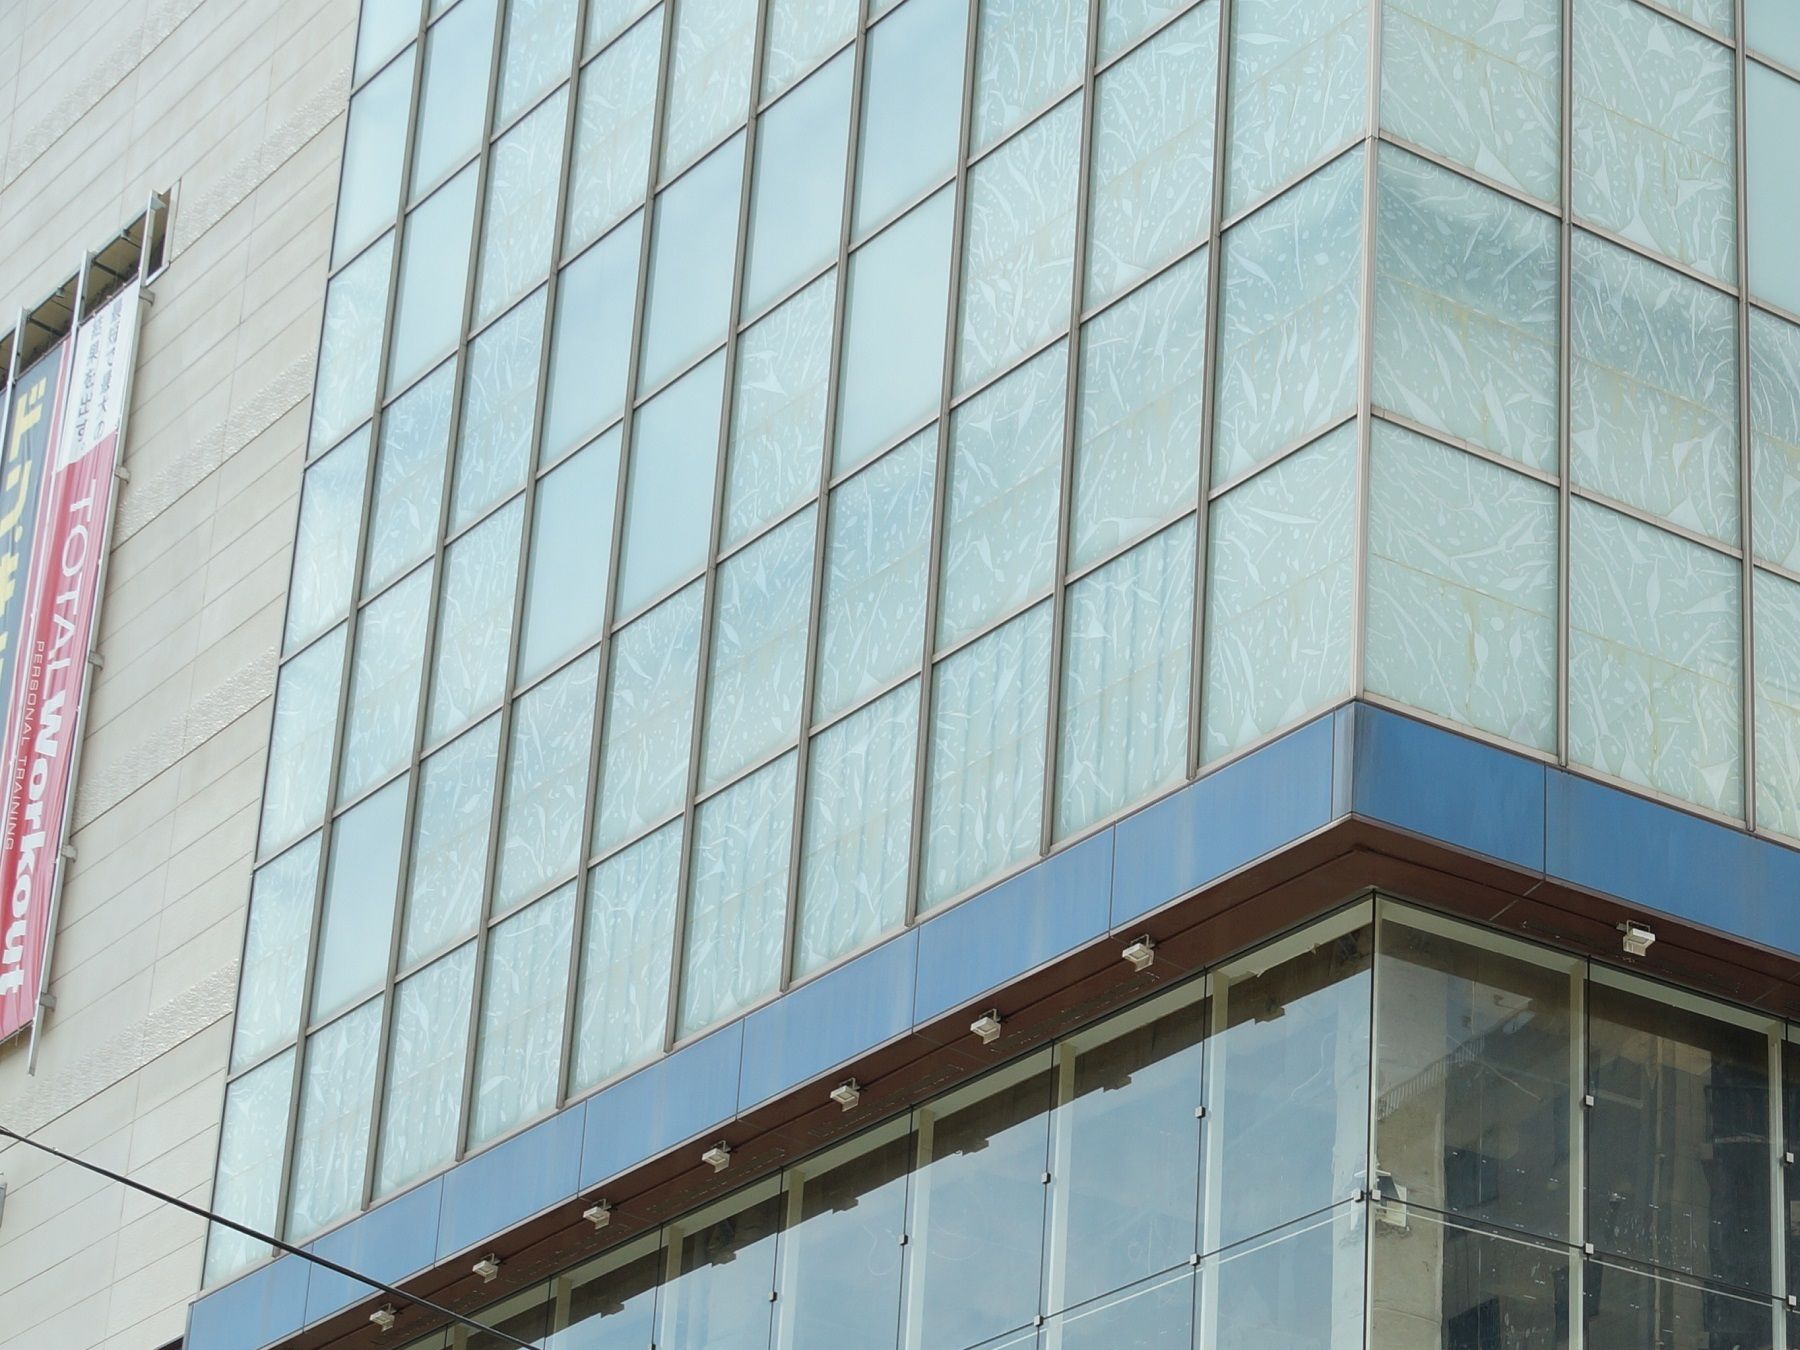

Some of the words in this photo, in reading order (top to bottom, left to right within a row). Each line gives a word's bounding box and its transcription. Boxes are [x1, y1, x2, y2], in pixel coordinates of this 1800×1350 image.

[42, 478, 98, 701] TOTAL
[20, 640, 46, 746] PERSONAL
[0, 689, 66, 997] Workout
[4, 755, 28, 852] TRAINING
